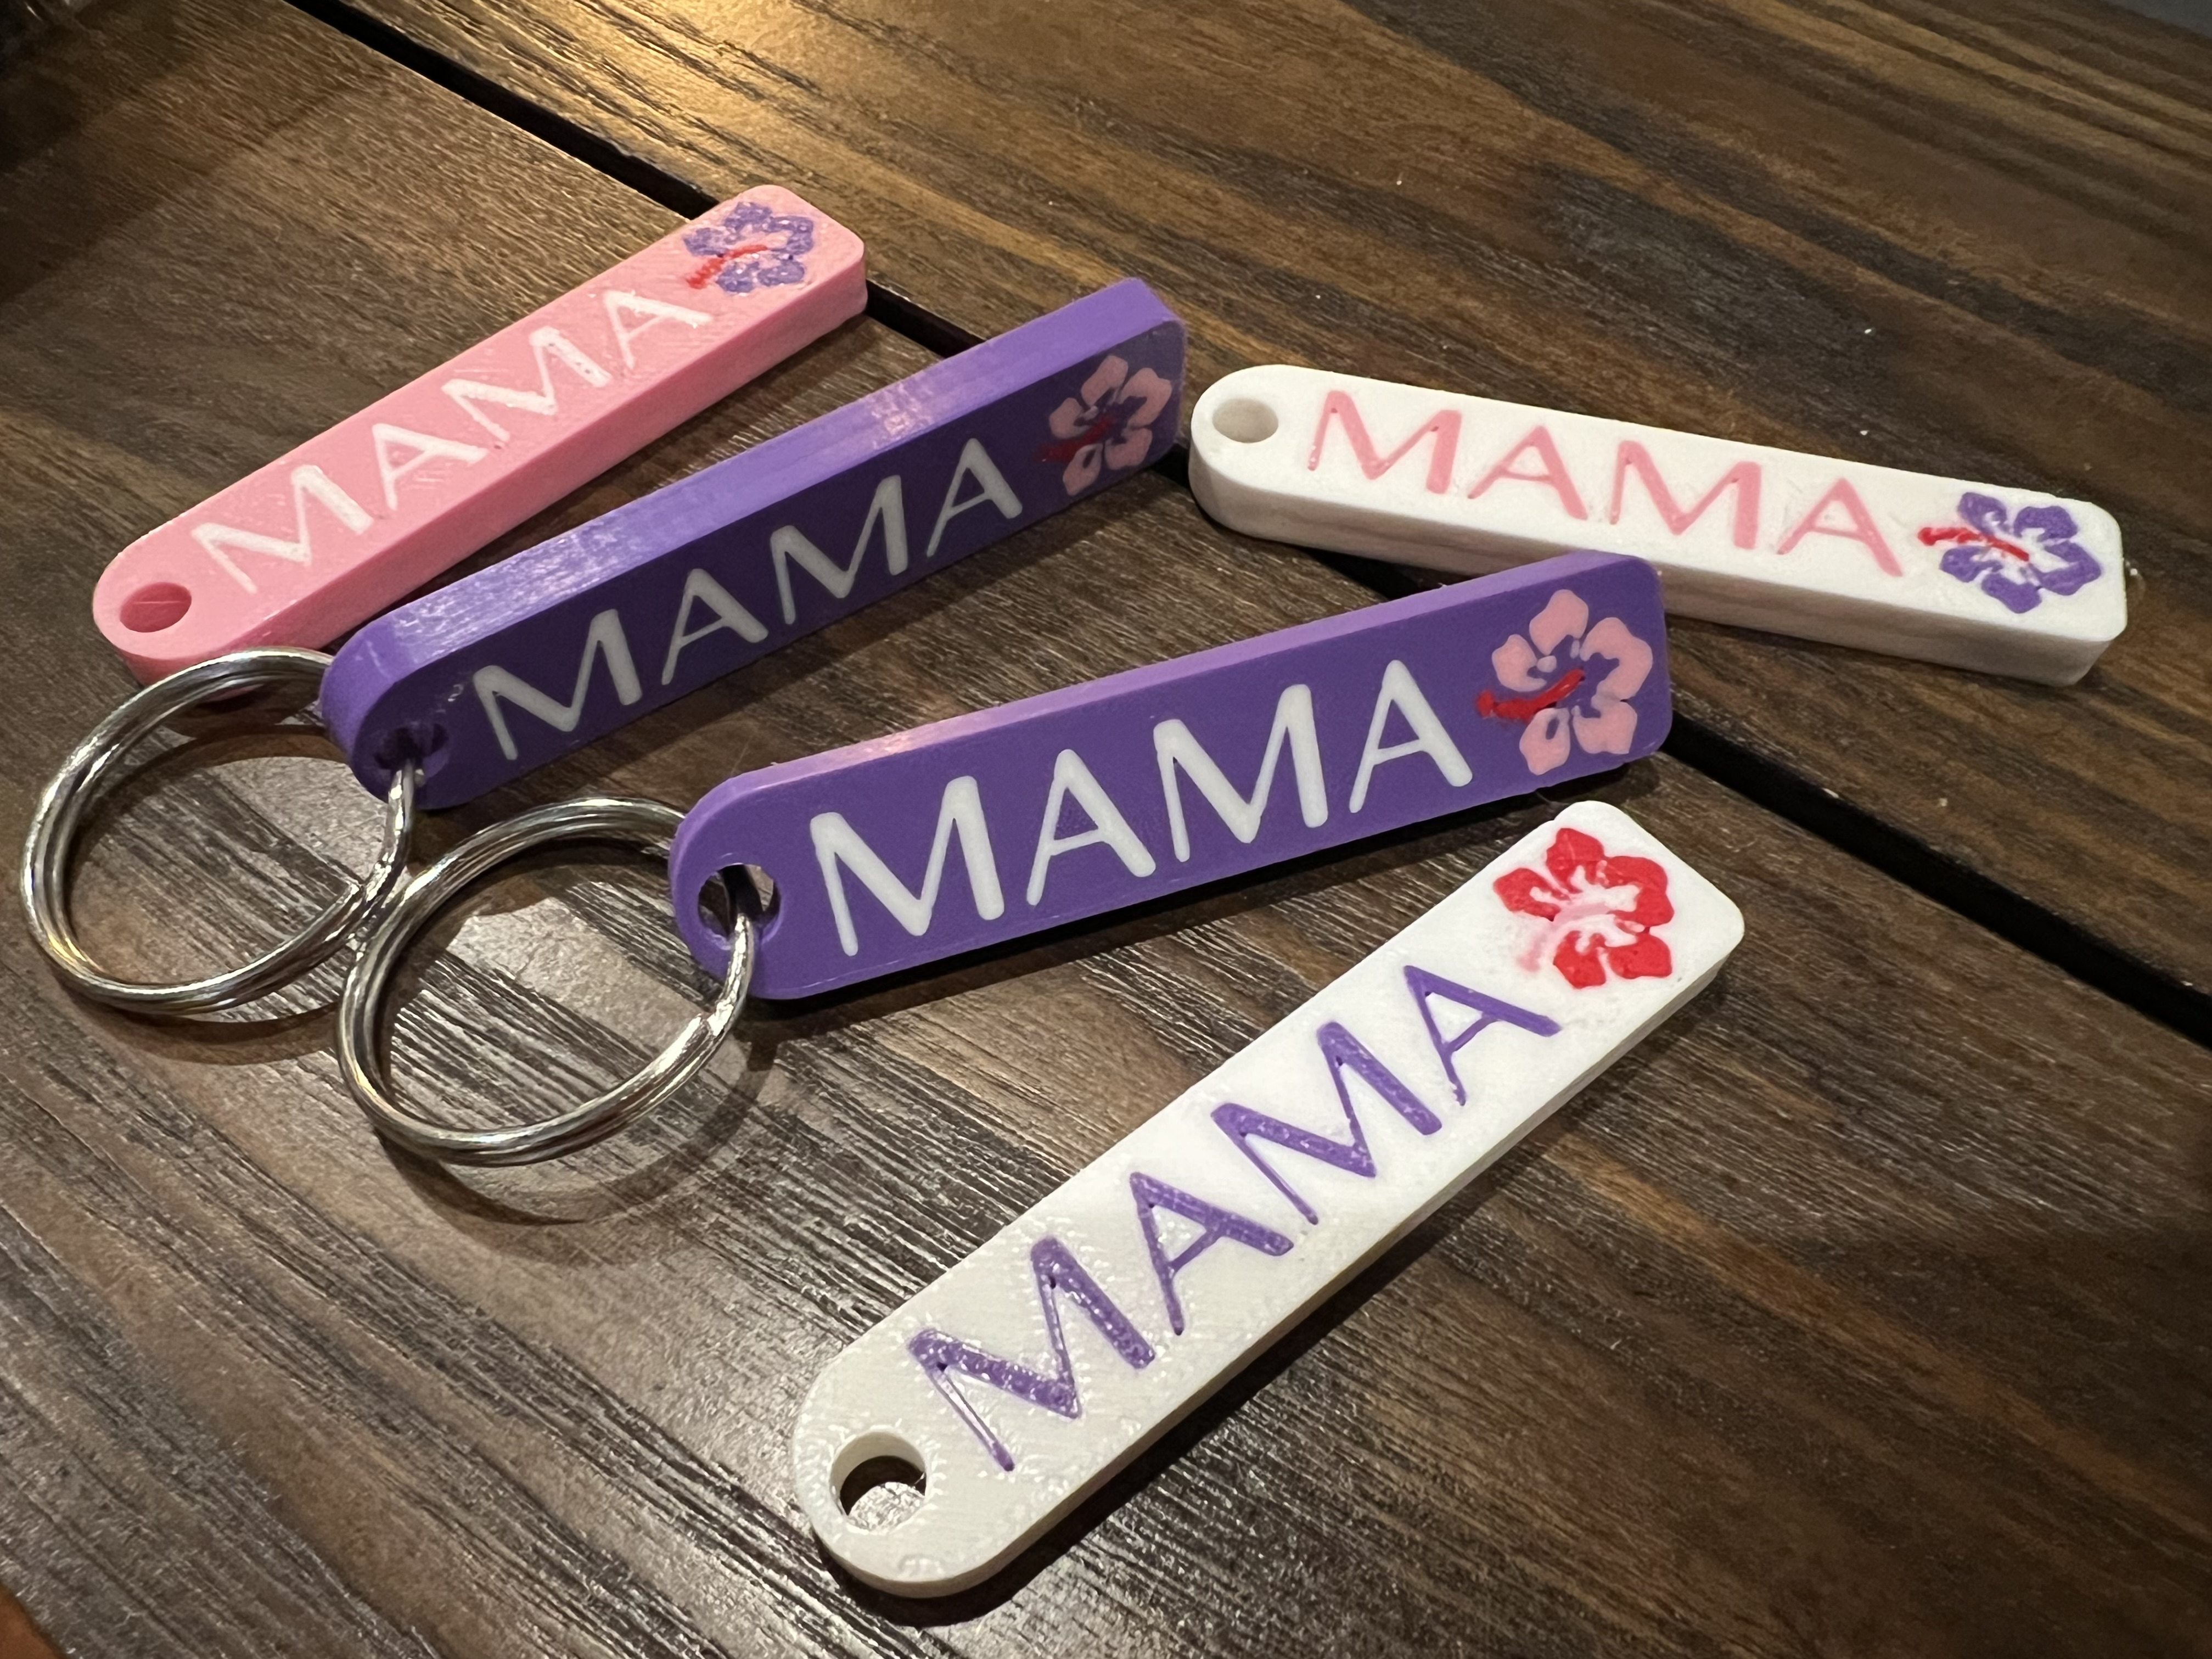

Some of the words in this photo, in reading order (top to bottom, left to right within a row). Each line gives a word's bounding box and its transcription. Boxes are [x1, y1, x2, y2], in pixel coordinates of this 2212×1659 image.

[193, 289, 711, 591] MAMA
[1311, 390, 1903, 578] MAMA
[473, 437, 1024, 761] MAMA
[810, 659, 1473, 955] MAMA
[909, 964, 1560, 1472] MAMA
